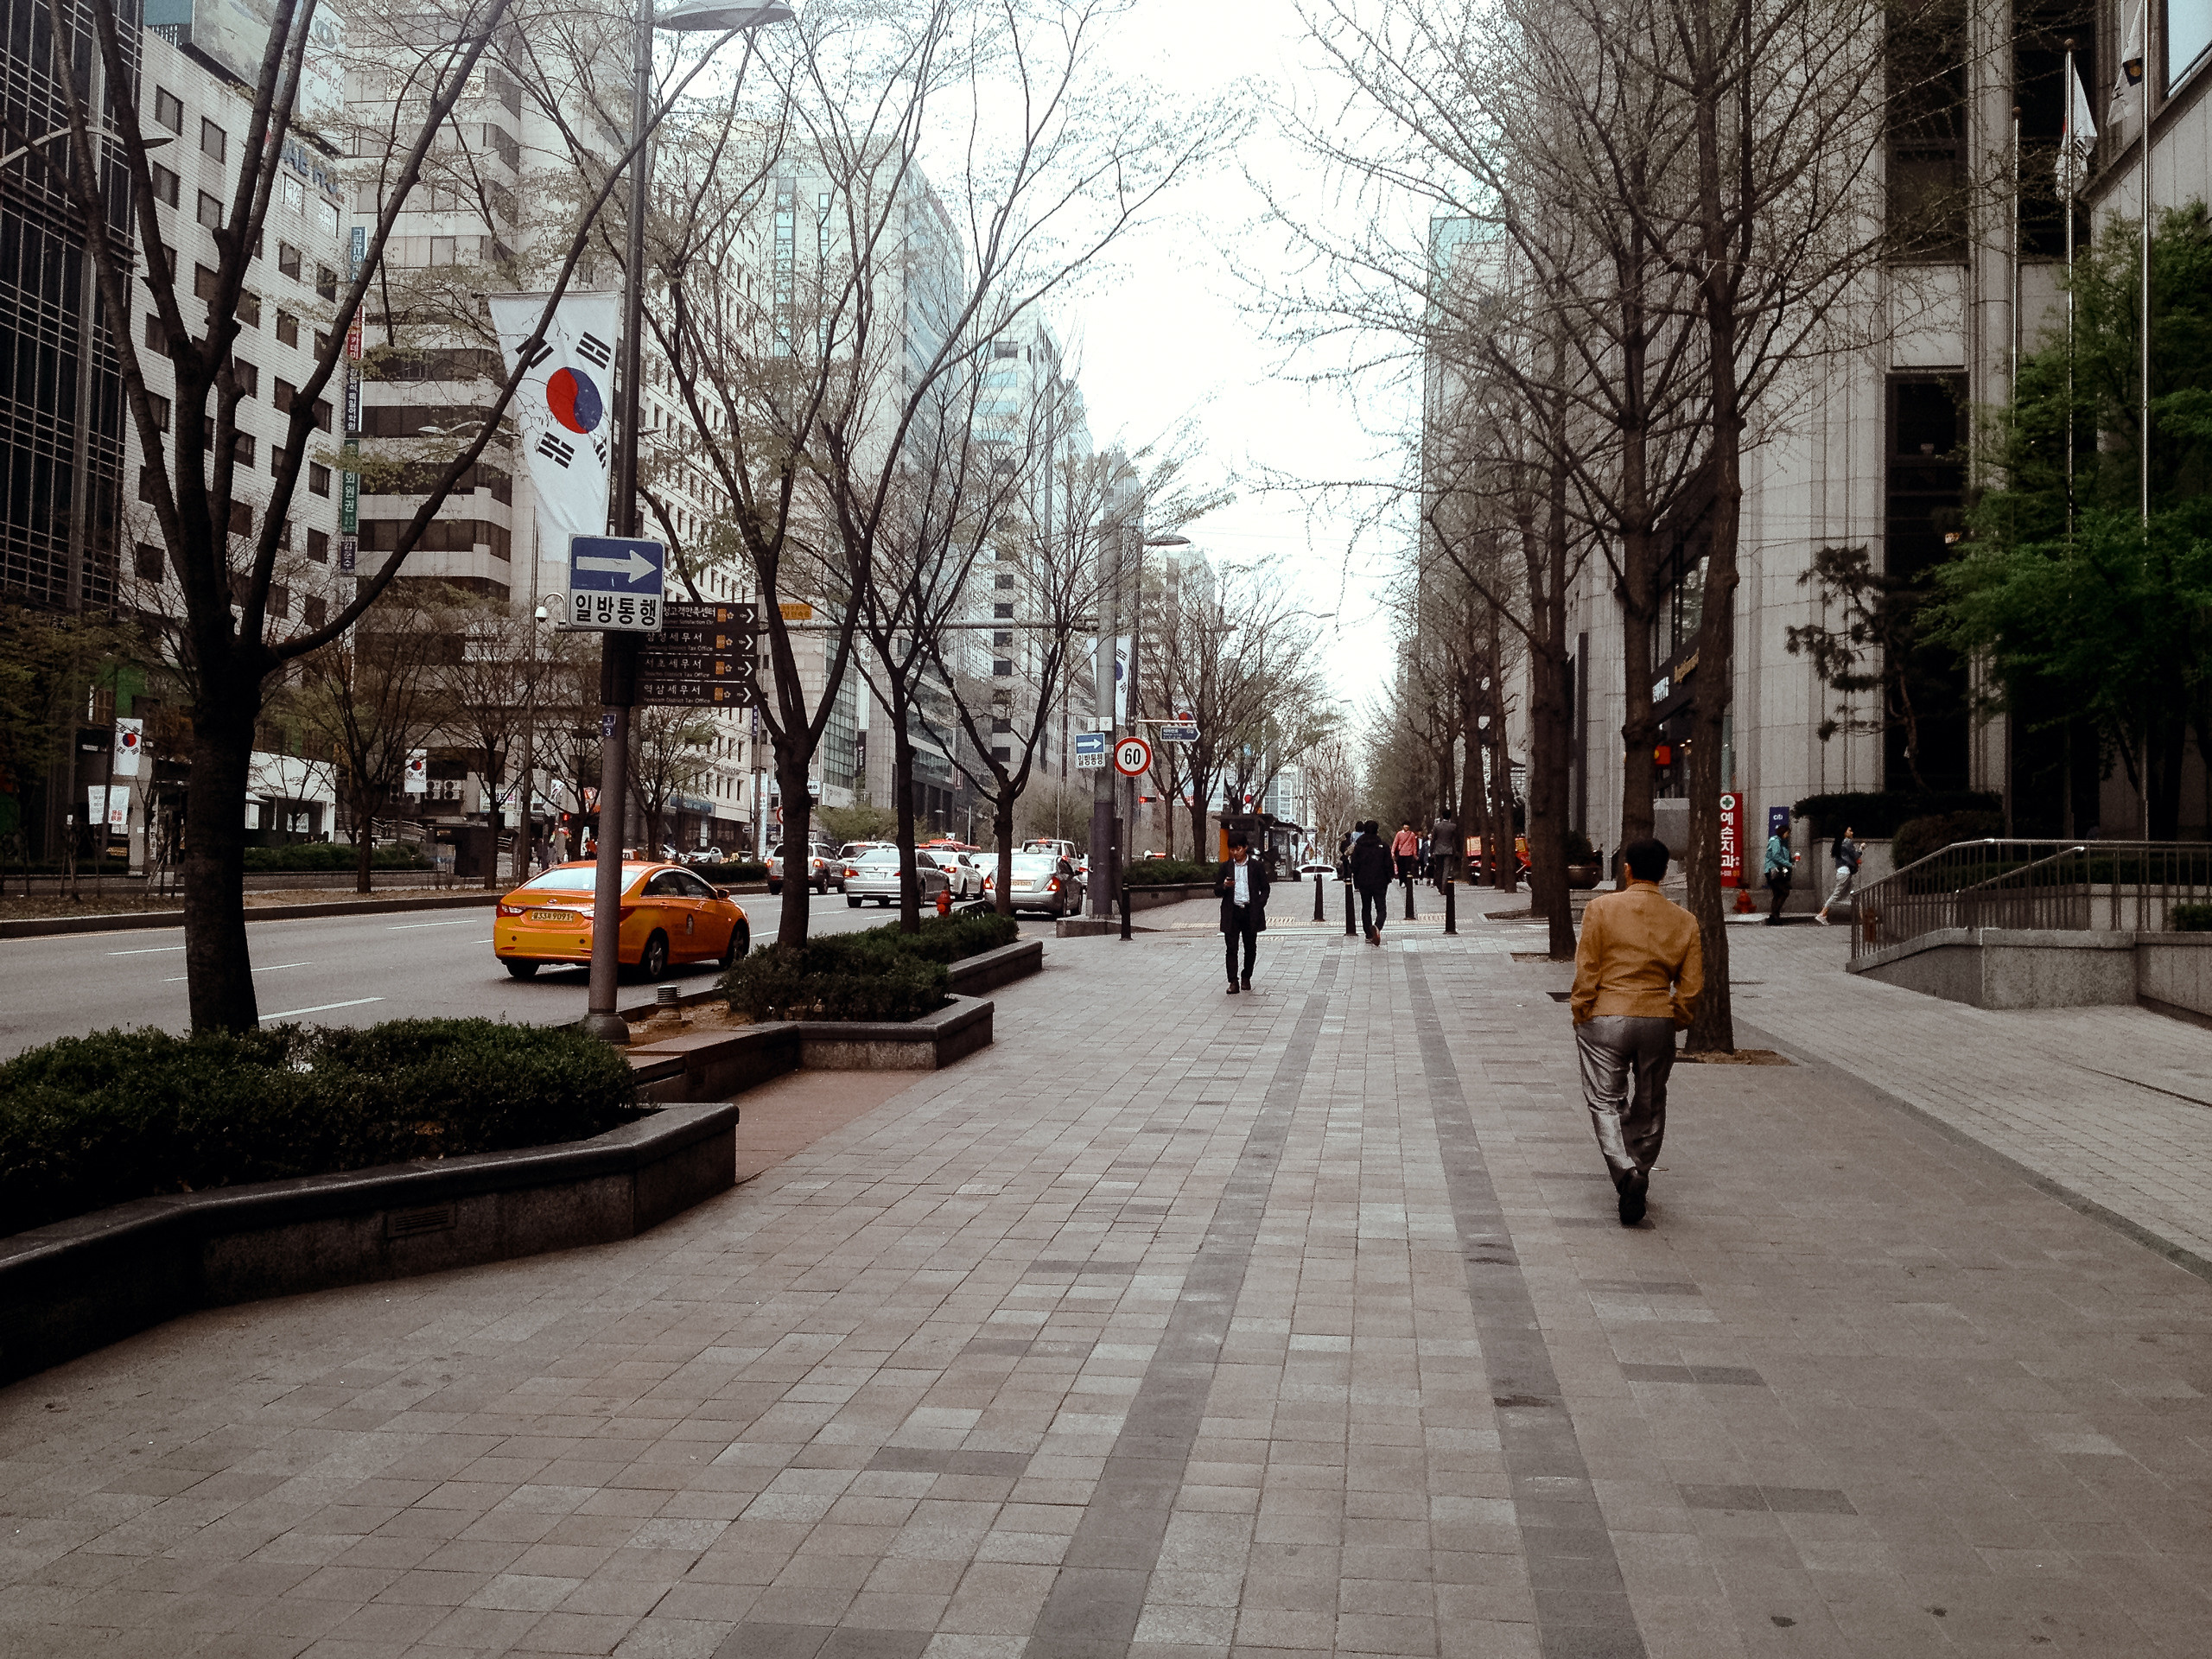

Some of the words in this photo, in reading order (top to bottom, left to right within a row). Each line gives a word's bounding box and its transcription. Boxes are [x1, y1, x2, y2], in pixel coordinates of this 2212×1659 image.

[575, 594, 657, 626] 일방통행
[1077, 753, 1103, 766] 일방통행
[1124, 747, 1141, 766] 60
[1720, 812, 1736, 868] 예손치과
